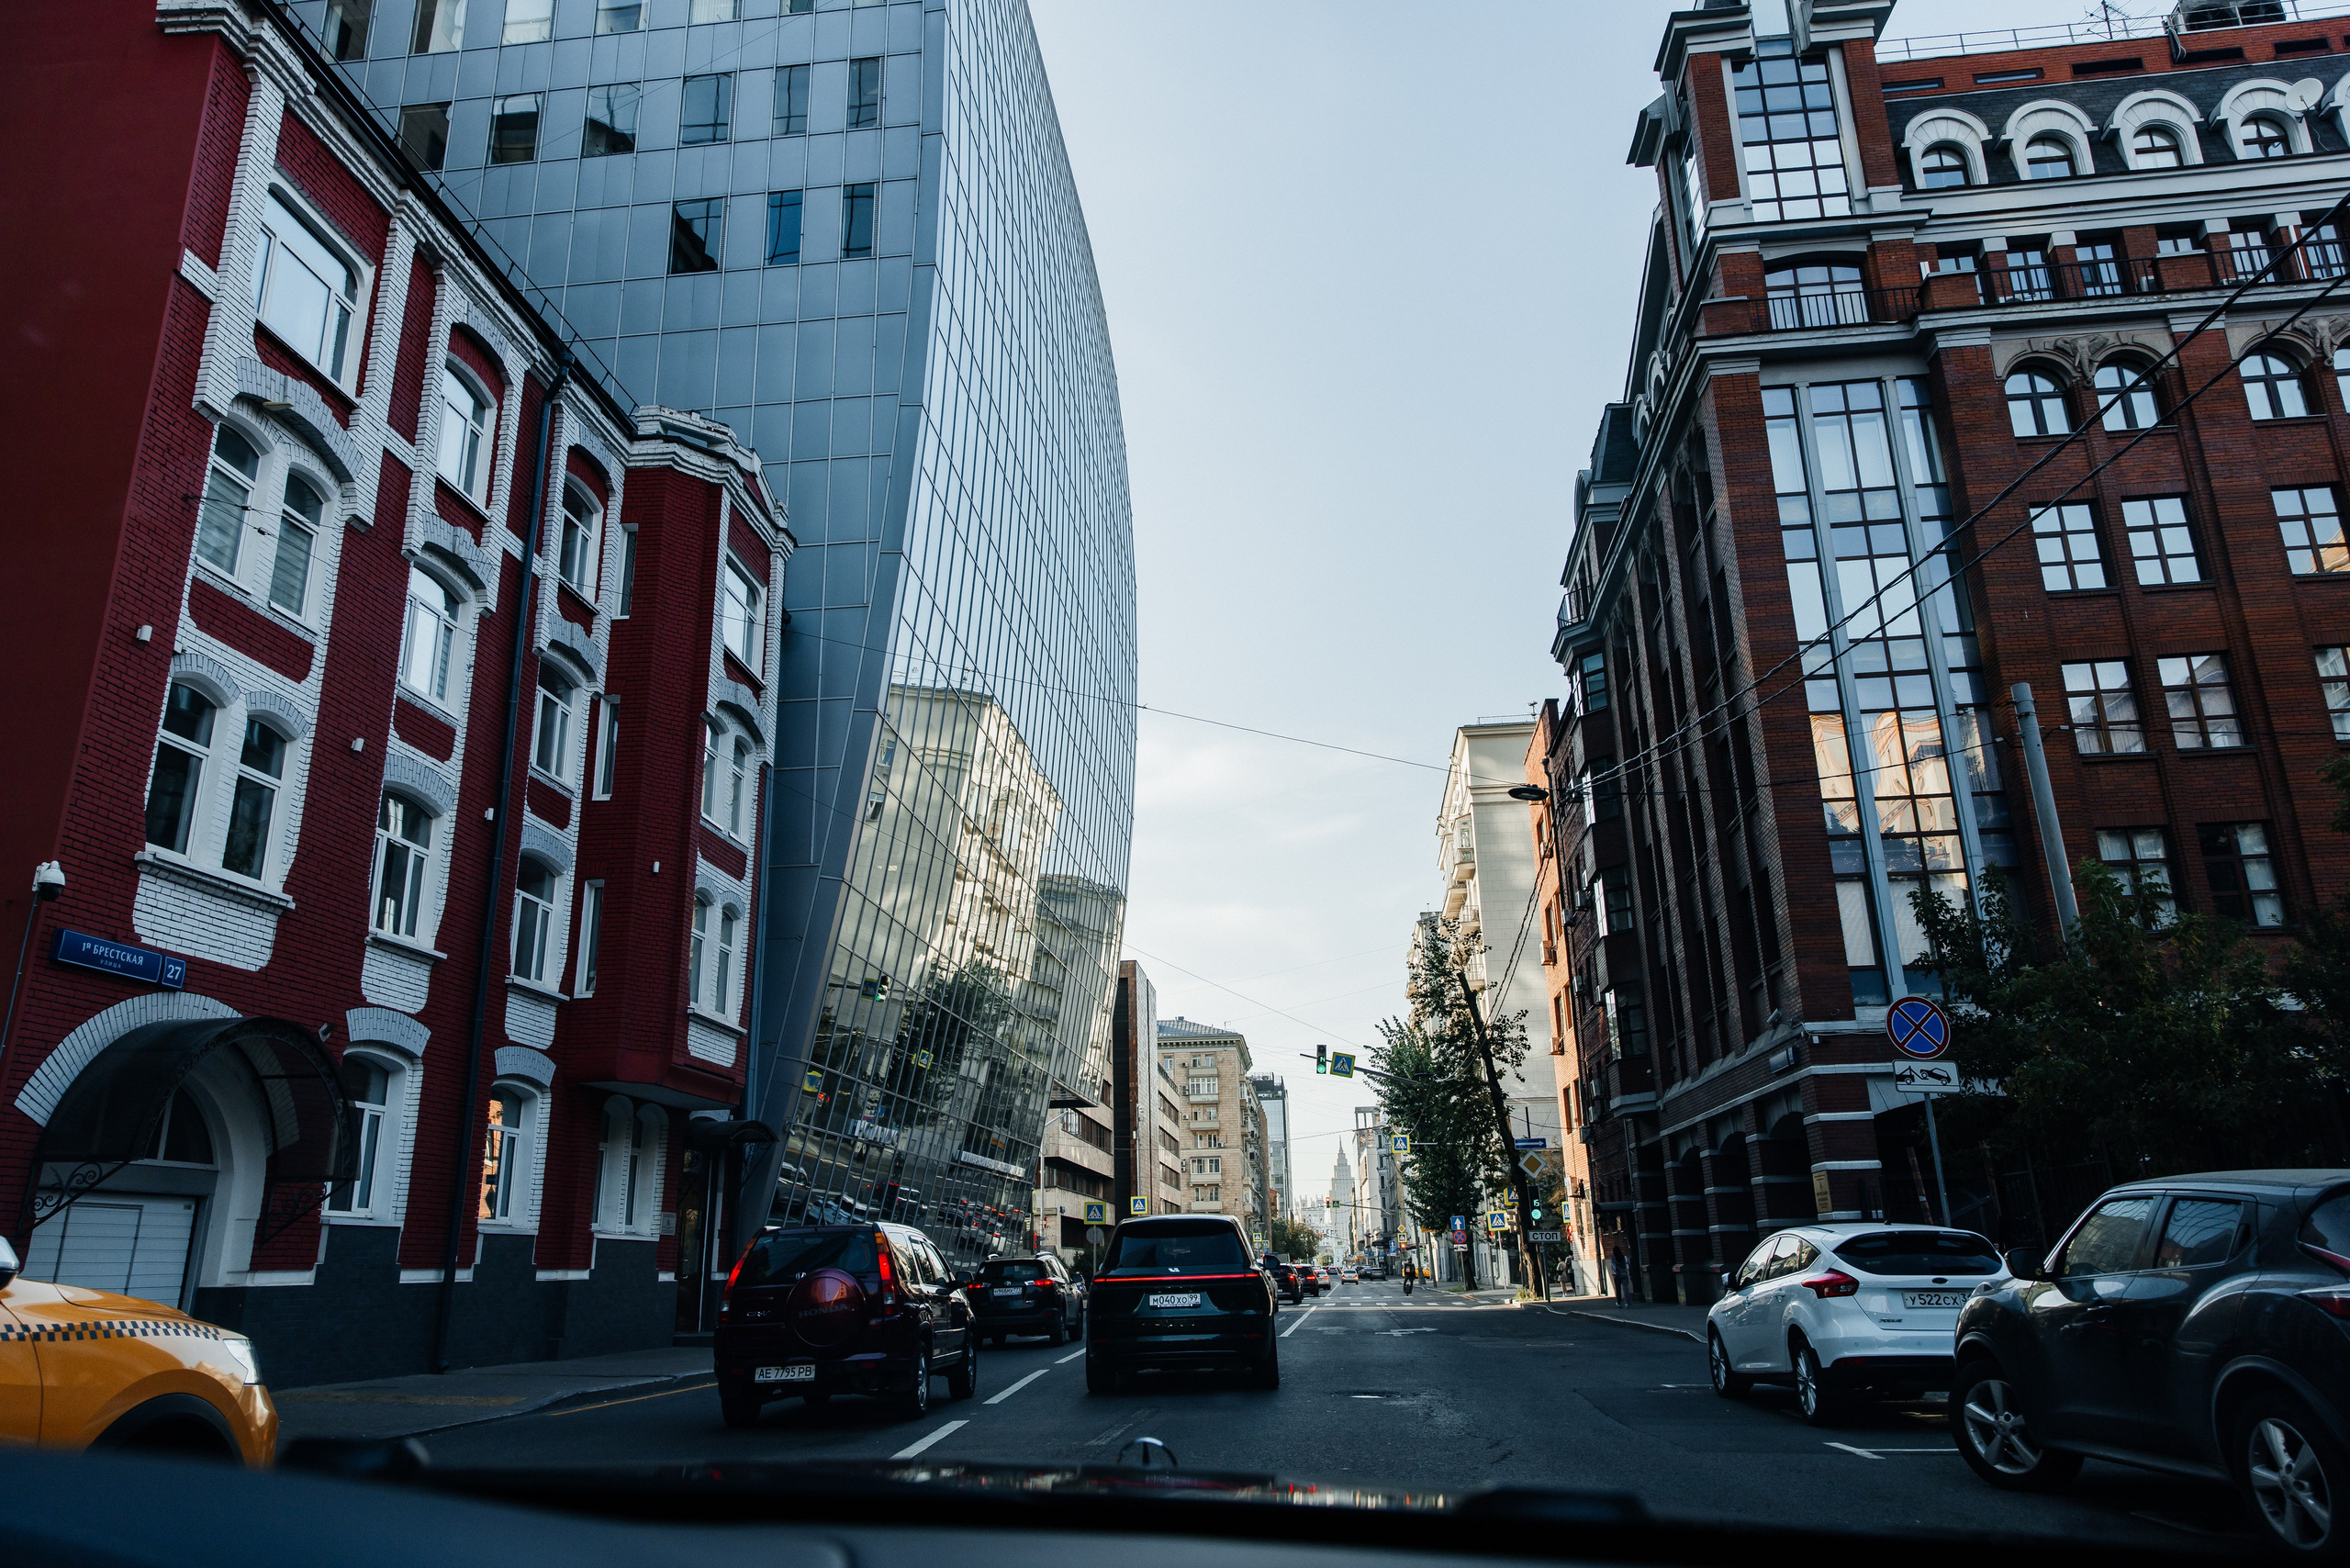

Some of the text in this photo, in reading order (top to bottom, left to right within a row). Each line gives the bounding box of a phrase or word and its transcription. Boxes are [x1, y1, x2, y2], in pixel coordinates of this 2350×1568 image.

[93, 945, 144, 966] БРЕСТСКАЯ
[166, 964, 182, 980] 27
[1532, 1232, 1558, 1240] СТОП
[798, 1304, 849, 1318] HONDA
